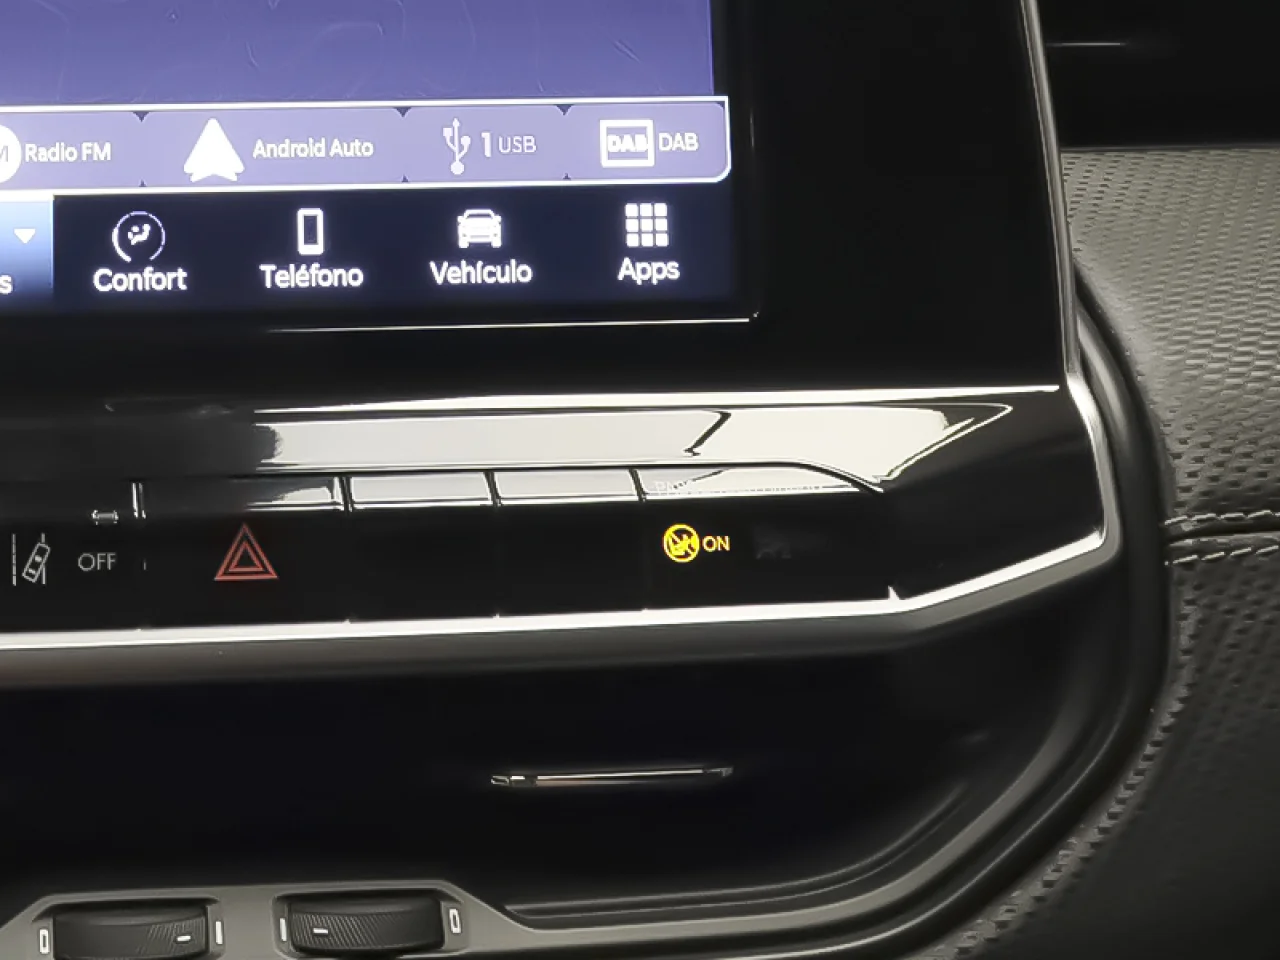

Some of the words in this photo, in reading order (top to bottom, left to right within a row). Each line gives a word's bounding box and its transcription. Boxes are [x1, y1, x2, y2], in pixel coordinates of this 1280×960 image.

[252, 139, 326, 158] Android
[329, 138, 374, 158] Auto
[497, 135, 537, 154] USB
[607, 135, 649, 153] DAB
[659, 132, 699, 152] DAB
[24, 144, 77, 163] Radio
[82, 143, 111, 162] FM
[93, 267, 188, 292] Confort
[260, 264, 364, 289] Teléfono
[430, 259, 533, 285] Vehículo
[618, 258, 680, 286] Apps
[703, 535, 731, 552] ON
[77, 553, 117, 572] OFF
